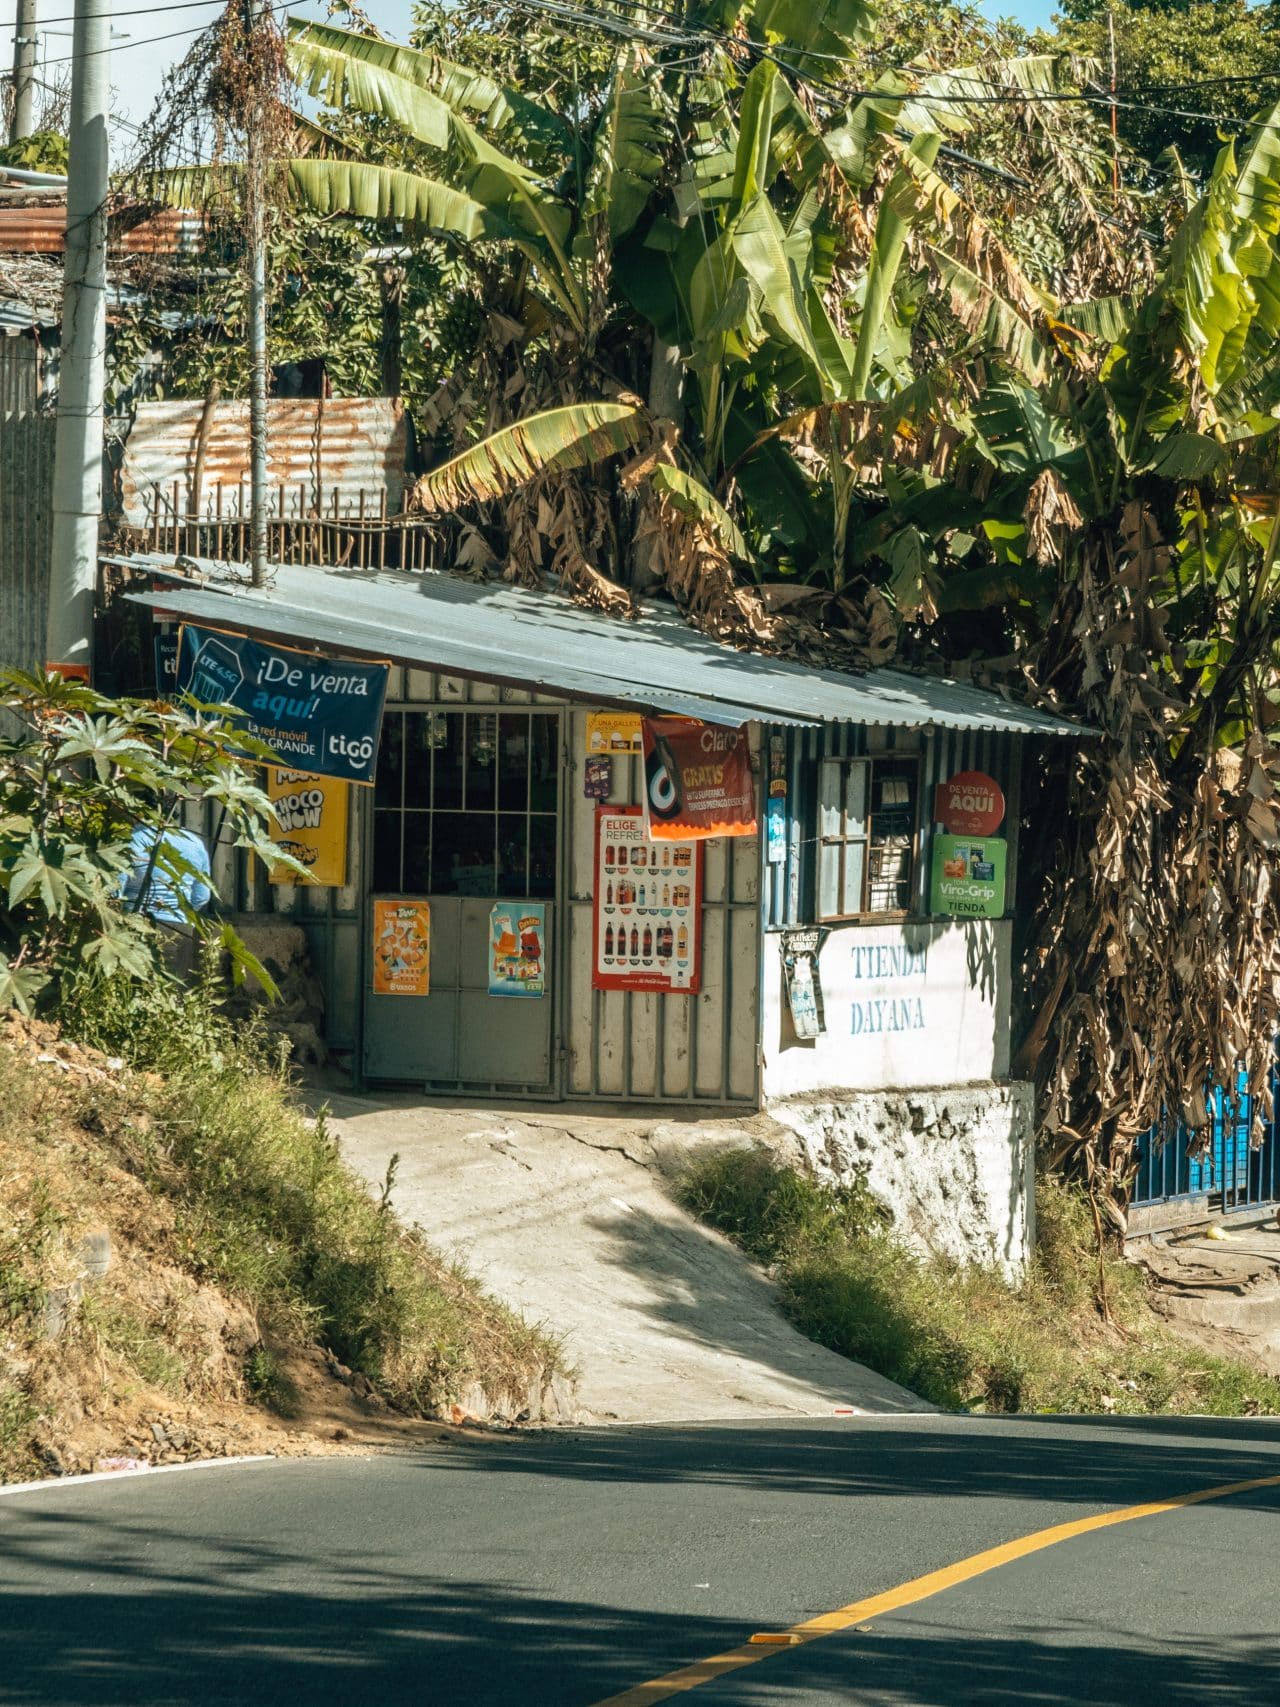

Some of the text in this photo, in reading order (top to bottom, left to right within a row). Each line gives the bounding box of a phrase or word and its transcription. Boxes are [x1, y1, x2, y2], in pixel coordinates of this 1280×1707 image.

[200, 655, 218, 670] LTE
[257, 657, 368, 695] ¡De venta
[248, 720, 308, 743] La red móvil
[268, 737, 316, 756] GRANDE
[329, 735, 374, 769] tigo
[683, 765, 724, 787] GRATIS
[950, 784, 989, 796] DE VENTA
[949, 793, 994, 813] AQUÍ
[606, 820, 637, 831] ELIGE
[940, 880, 995, 901] Viro-Grip
[948, 901, 986, 913] TIENDA
[851, 943, 927, 979] TIENDA
[850, 997, 926, 1035] DAYANA
